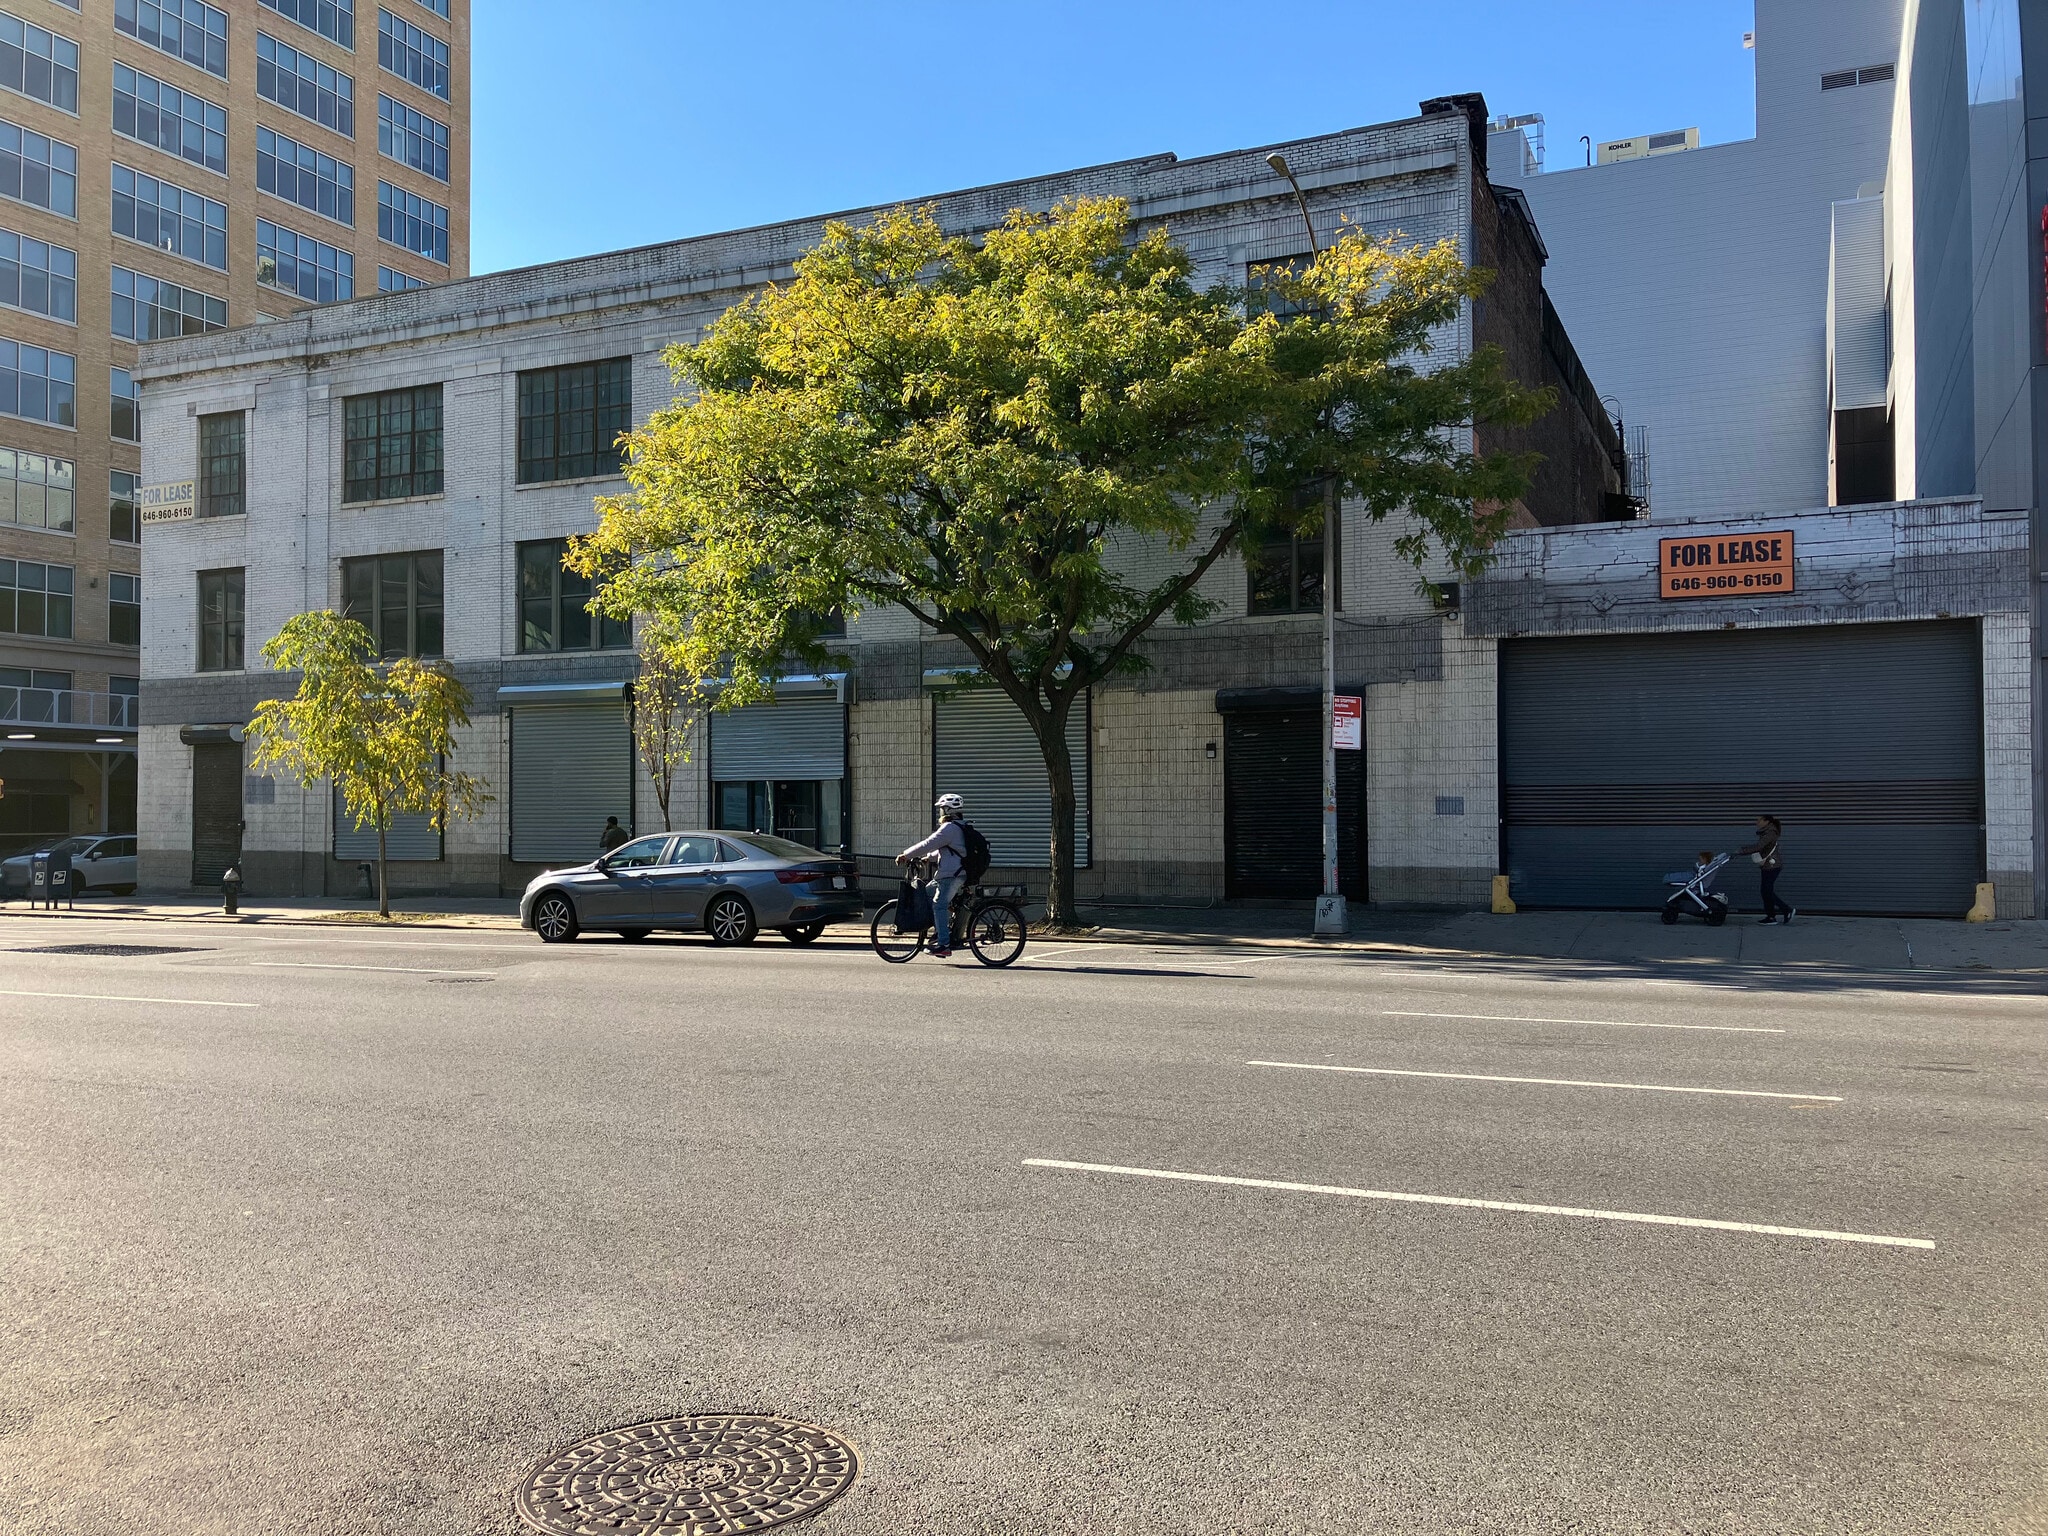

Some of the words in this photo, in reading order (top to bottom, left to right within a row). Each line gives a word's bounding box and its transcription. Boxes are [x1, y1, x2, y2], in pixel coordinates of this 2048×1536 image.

[1608, 142, 1632, 151] KOHLER
[143, 488, 161, 504] FOR
[163, 484, 192, 503] LEASE
[142, 507, 192, 521] 646-960-6150
[1670, 544, 1711, 567] FOR
[1717, 539, 1782, 564] LEASE
[1671, 573, 1782, 591] 646-960-6150
